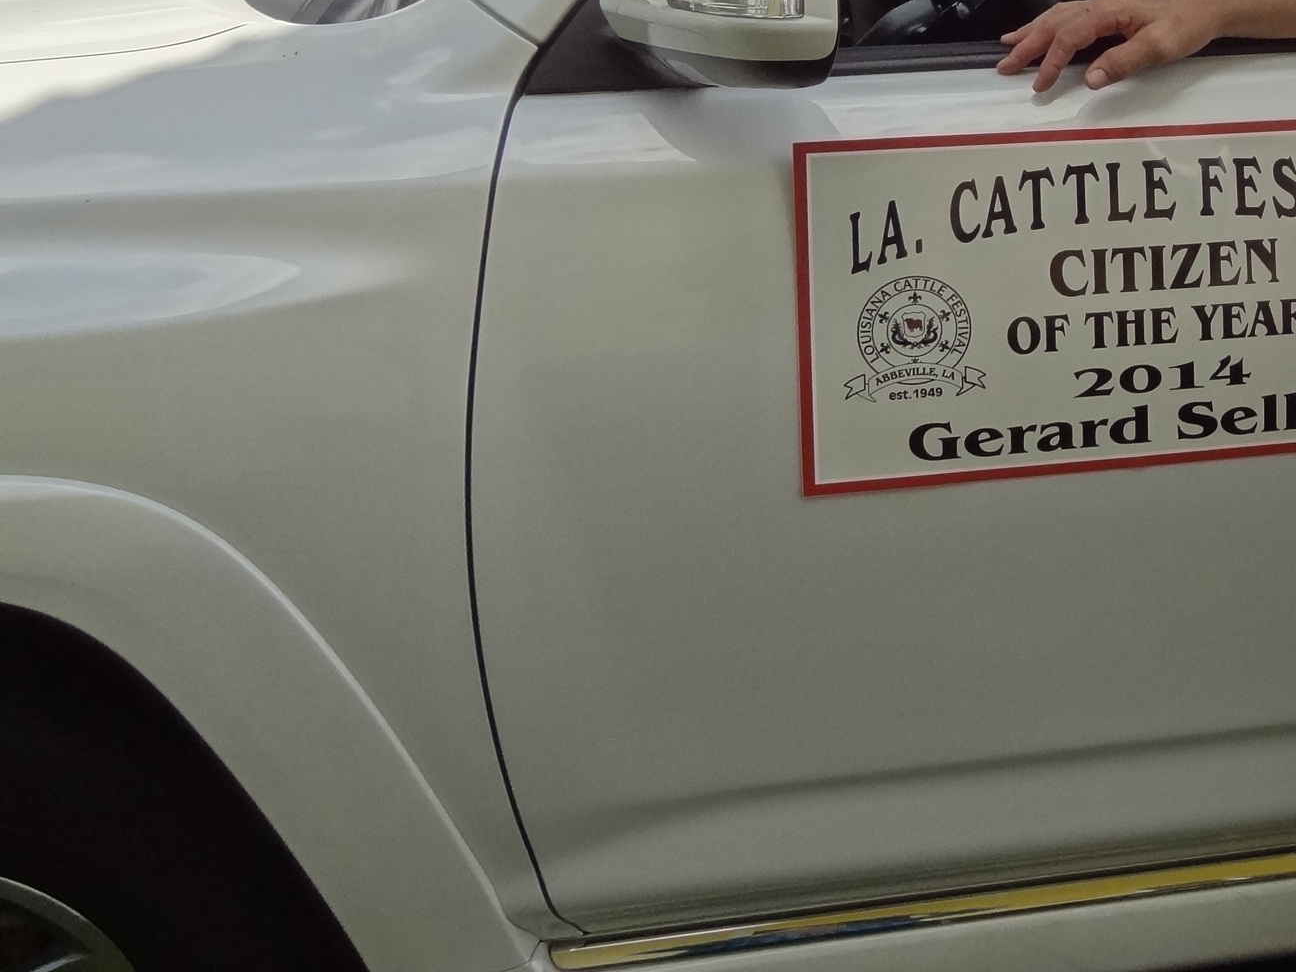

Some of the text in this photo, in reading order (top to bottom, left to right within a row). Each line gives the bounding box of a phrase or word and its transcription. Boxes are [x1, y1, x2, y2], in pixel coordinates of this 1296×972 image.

[849, 199, 923, 276] LA.
[949, 156, 1177, 244] CATTLE
[1049, 237, 1280, 298] CITIZEN
[860, 278, 969, 364] LOUISIANA CATTLE FESTIVAL
[1006, 313, 1070, 356] OF
[1083, 306, 1179, 350] THE
[875, 367, 956, 386] ABBEVILLE, LA
[1073, 354, 1252, 399] 2014
[908, 403, 1152, 462] Gerard
